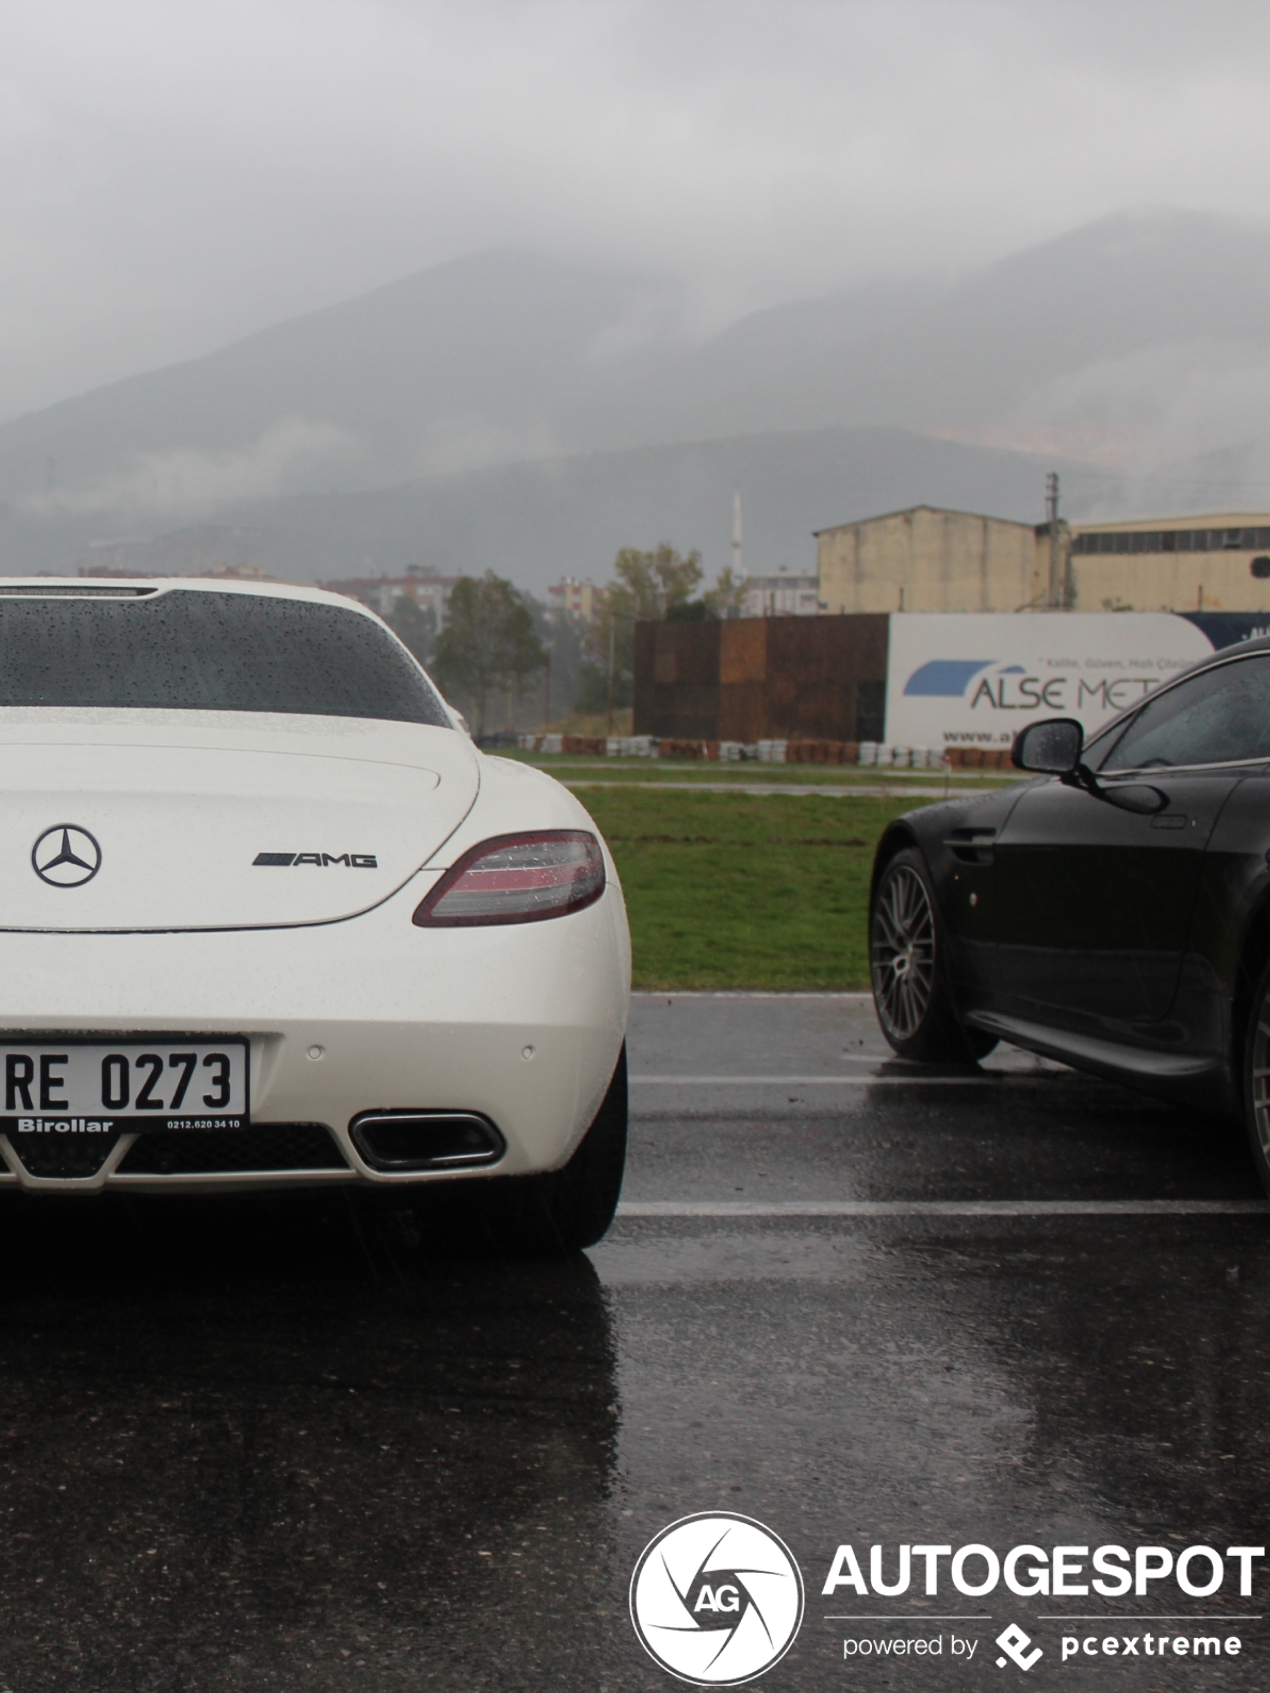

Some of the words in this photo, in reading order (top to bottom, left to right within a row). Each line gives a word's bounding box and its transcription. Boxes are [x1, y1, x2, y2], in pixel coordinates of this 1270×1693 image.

[970, 678, 1066, 709] ALSE
[1077, 678, 1160, 710] MET
[292, 852, 378, 868] AMG
[5, 1054, 69, 1110] RE
[101, 1053, 231, 1110] 0273
[18, 1118, 114, 1133] Birollar
